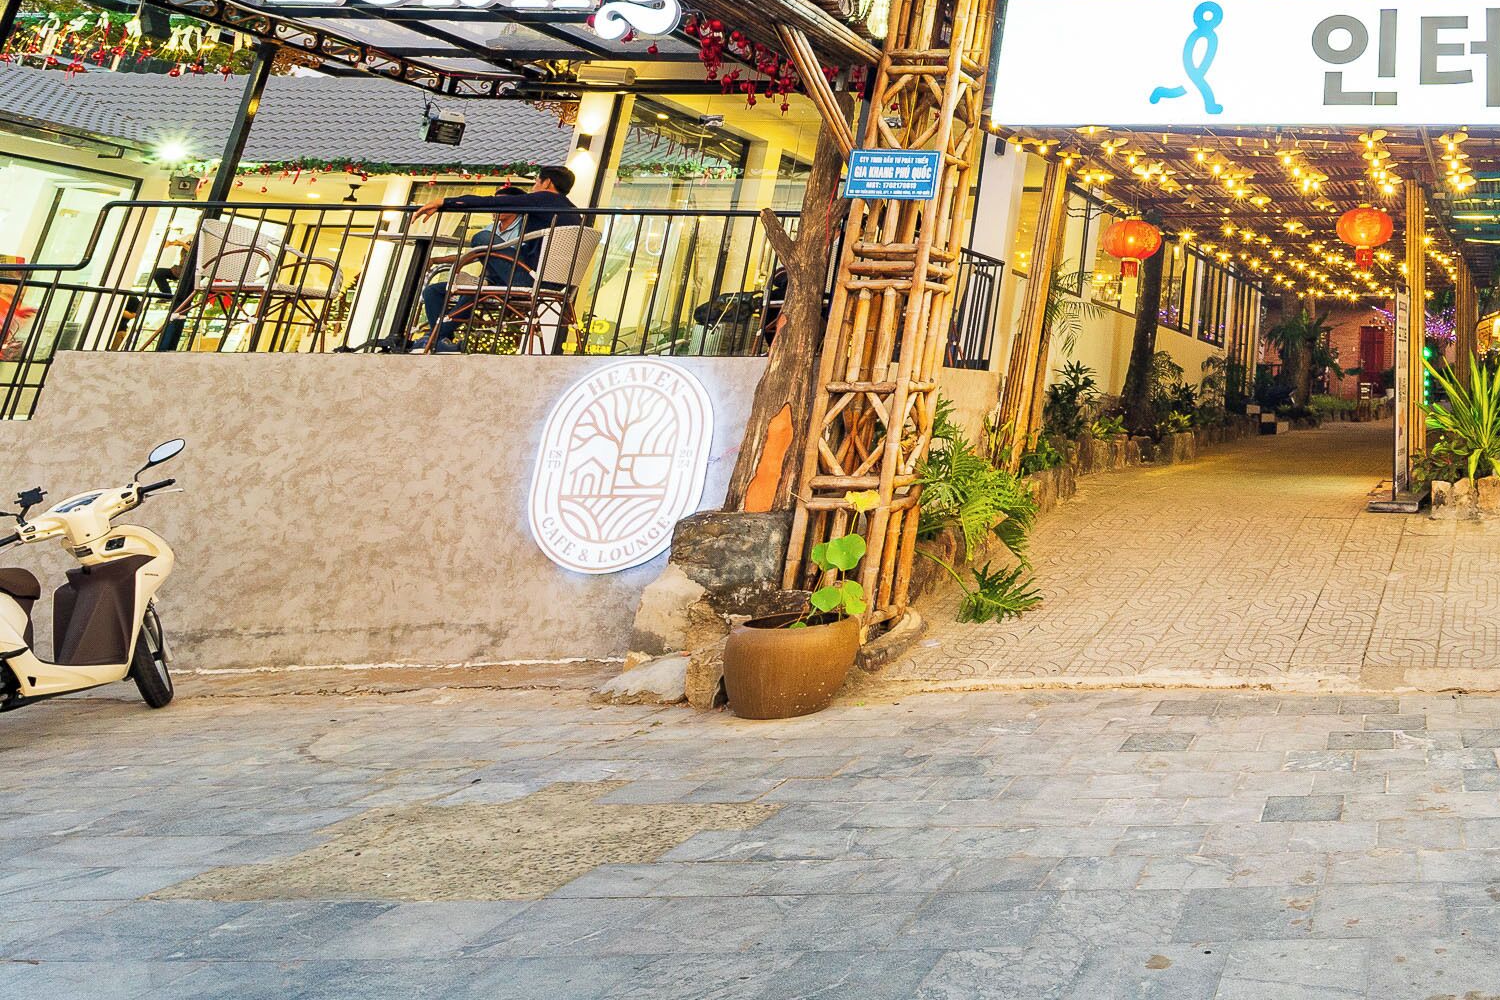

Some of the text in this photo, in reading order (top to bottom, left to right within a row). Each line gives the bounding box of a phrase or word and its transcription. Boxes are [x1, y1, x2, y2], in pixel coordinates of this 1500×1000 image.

[587, 366, 686, 397] HEAVEN
[542, 516, 672, 563] CAFE & LOUNGE
